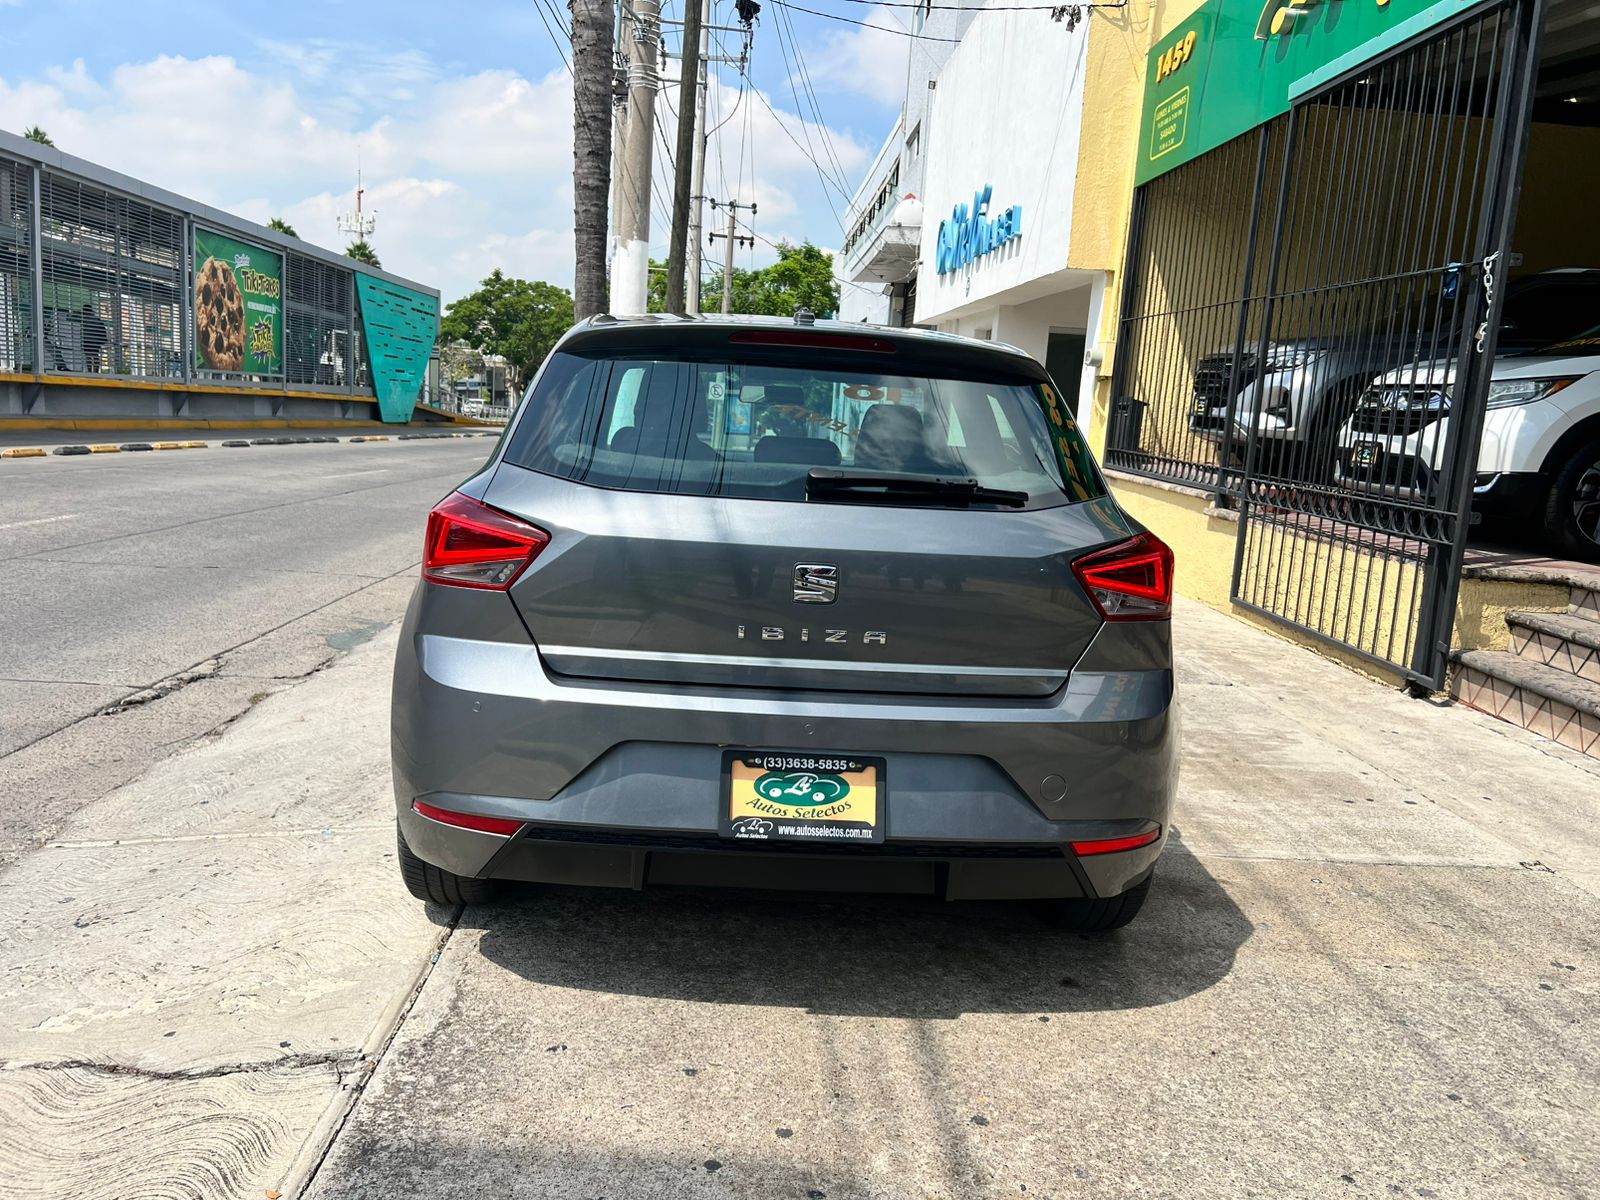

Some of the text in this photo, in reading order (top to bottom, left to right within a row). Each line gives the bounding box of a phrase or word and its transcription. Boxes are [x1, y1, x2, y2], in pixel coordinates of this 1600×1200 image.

[1156, 31, 1196, 83] 1459
[737, 625, 887, 645] IBIZA
[763, 757, 847, 770] (33)3638-5835
[746, 798, 852, 819] Autos Selectos
[778, 824, 873, 839] www.autosselectos.com.mx
